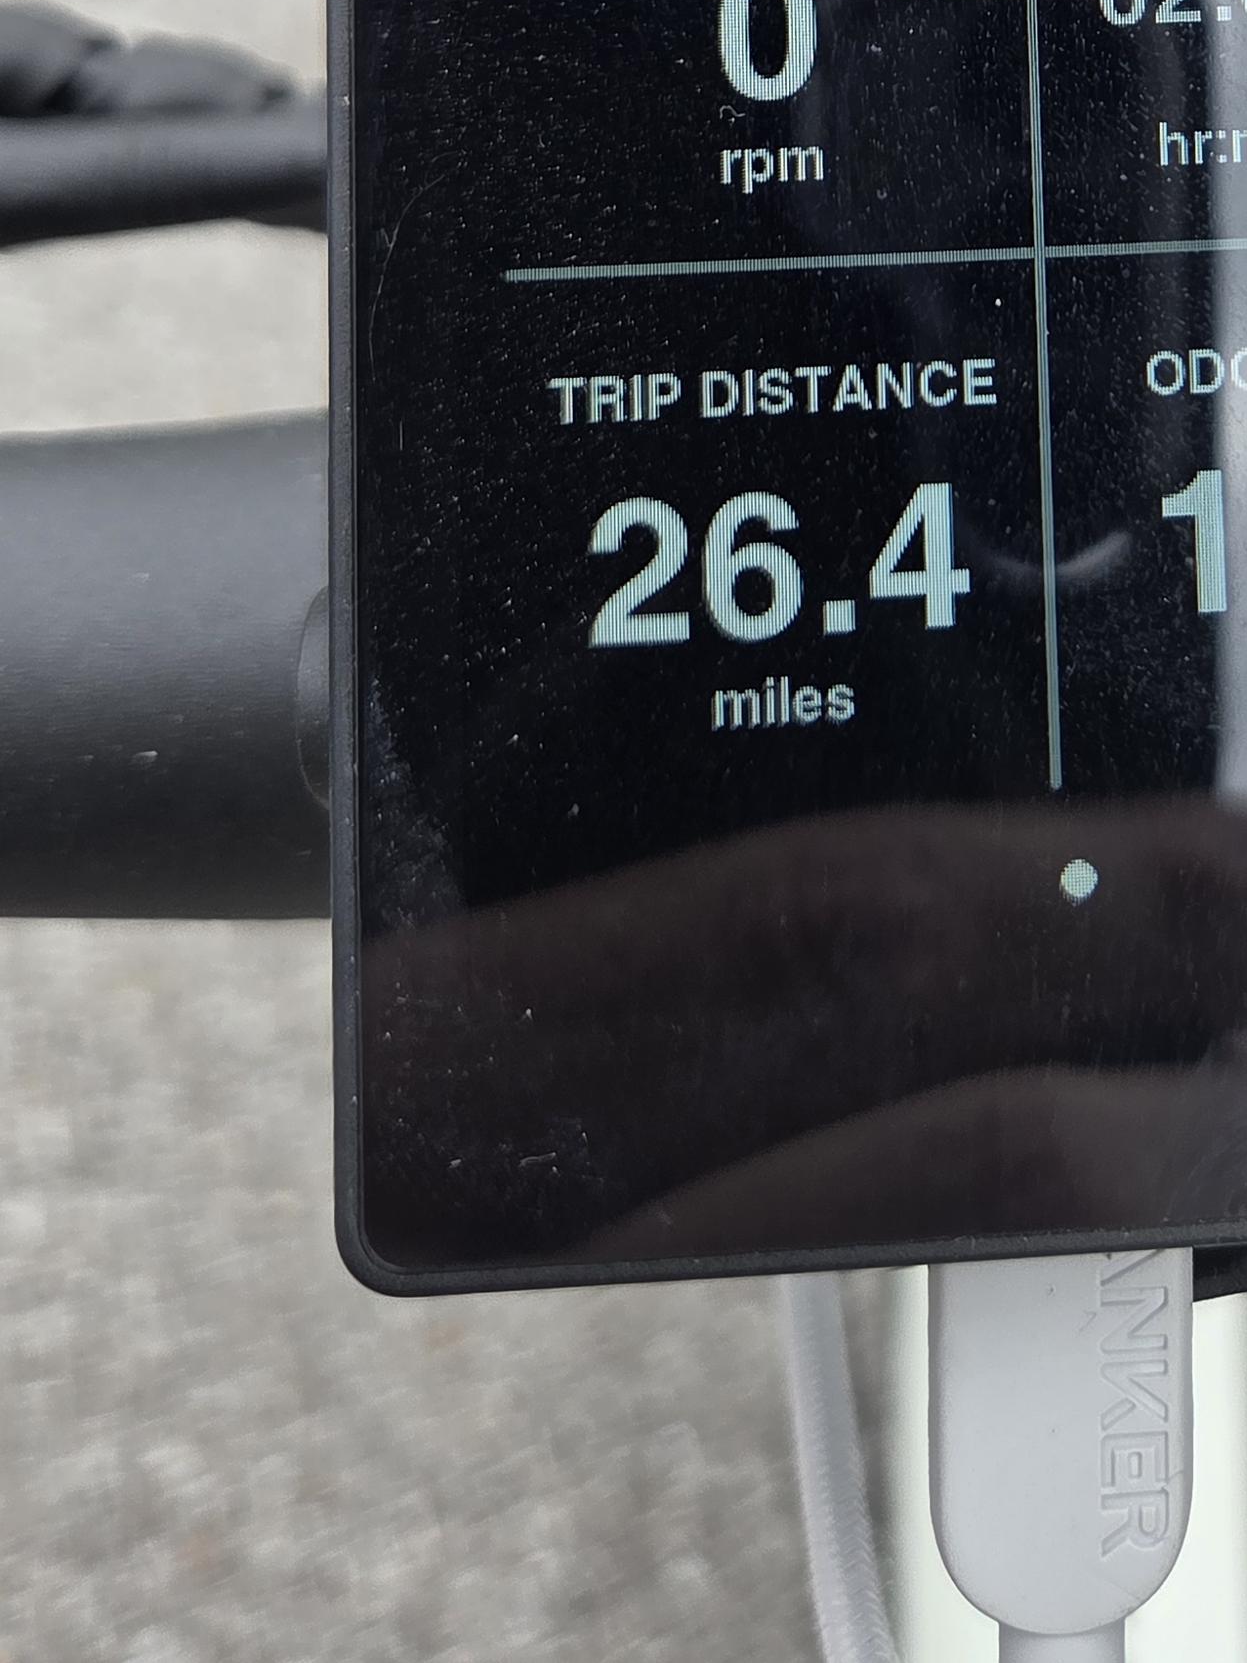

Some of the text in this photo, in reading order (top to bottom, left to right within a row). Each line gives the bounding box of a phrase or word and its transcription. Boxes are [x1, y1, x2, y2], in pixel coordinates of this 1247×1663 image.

[720, 141, 825, 194] rpm
[548, 358, 998, 426] TRIP DISTANCE
[587, 481, 970, 648] 26.4
[711, 676, 856, 733] miles
